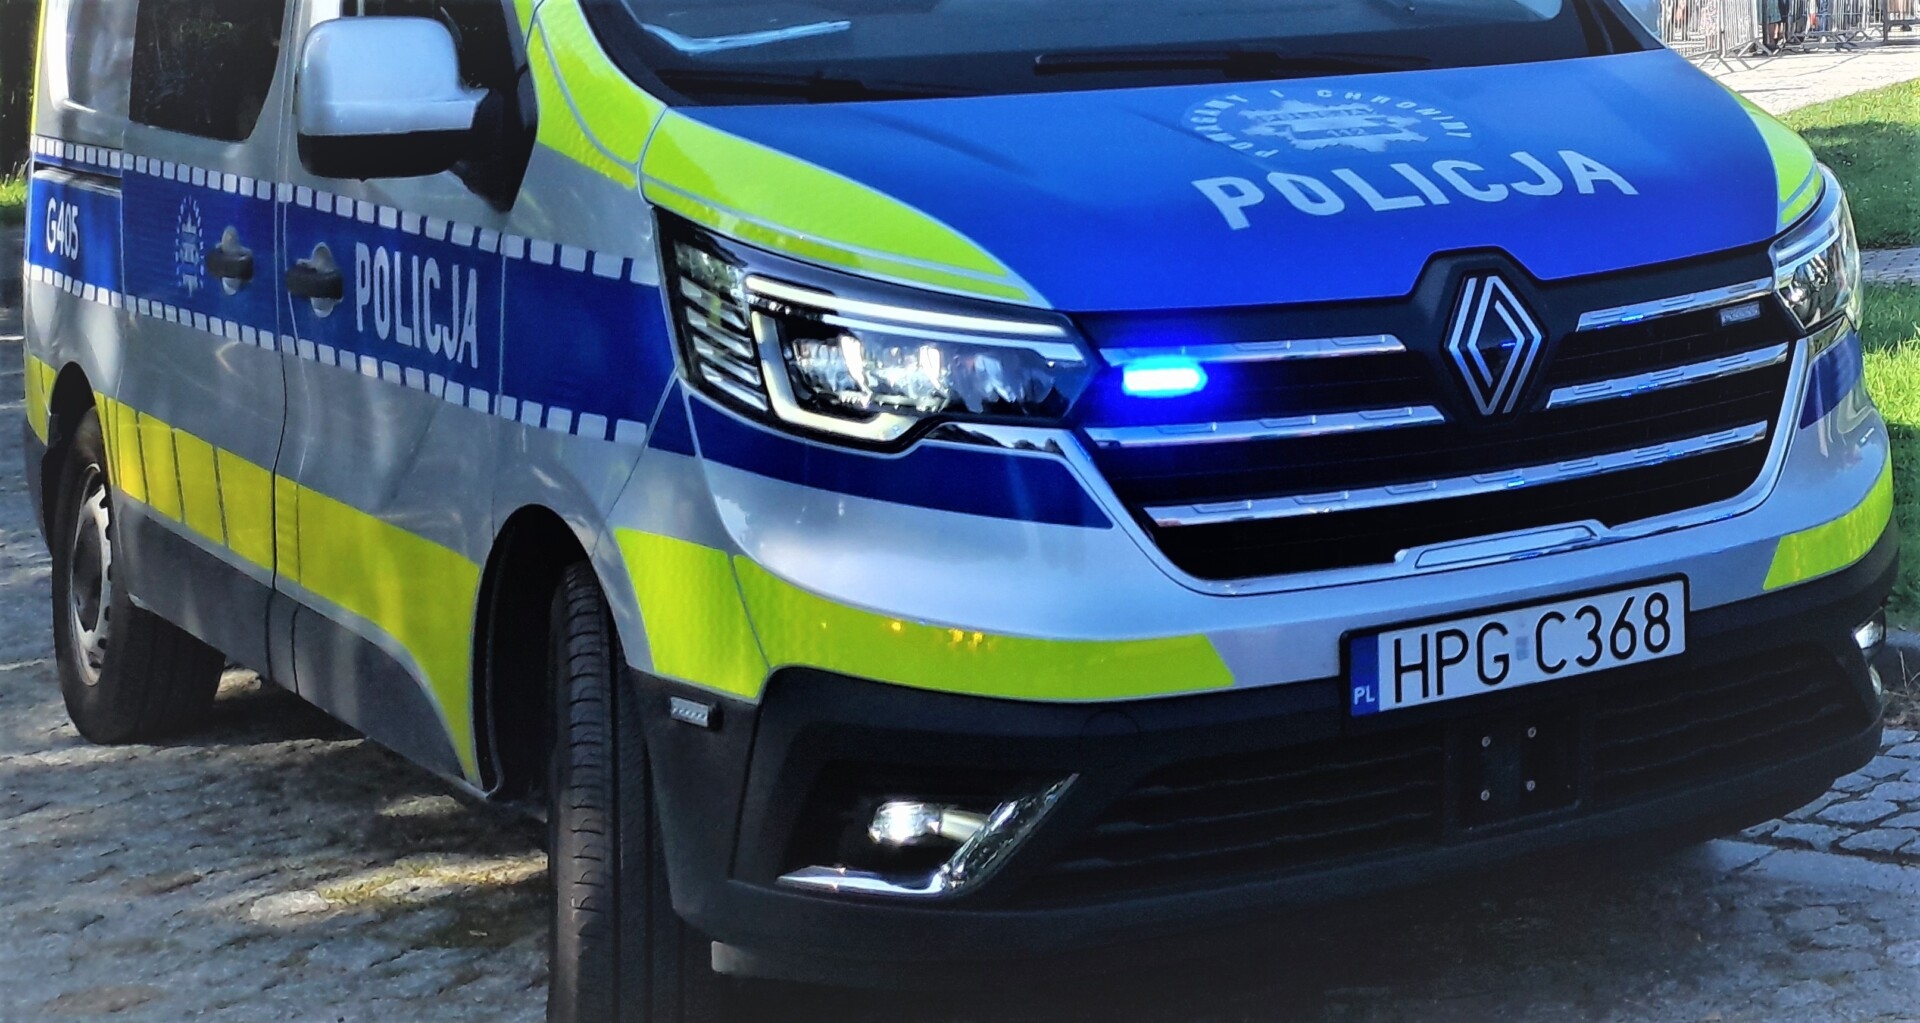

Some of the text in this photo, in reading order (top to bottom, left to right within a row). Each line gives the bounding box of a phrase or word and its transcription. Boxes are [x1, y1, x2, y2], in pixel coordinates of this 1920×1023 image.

[46, 197, 79, 261] G405
[1191, 149, 1640, 231] POLICJA
[355, 242, 479, 369] POLICJA
[1394, 591, 1671, 704] HPG C368
[1353, 685, 1376, 705] PL
